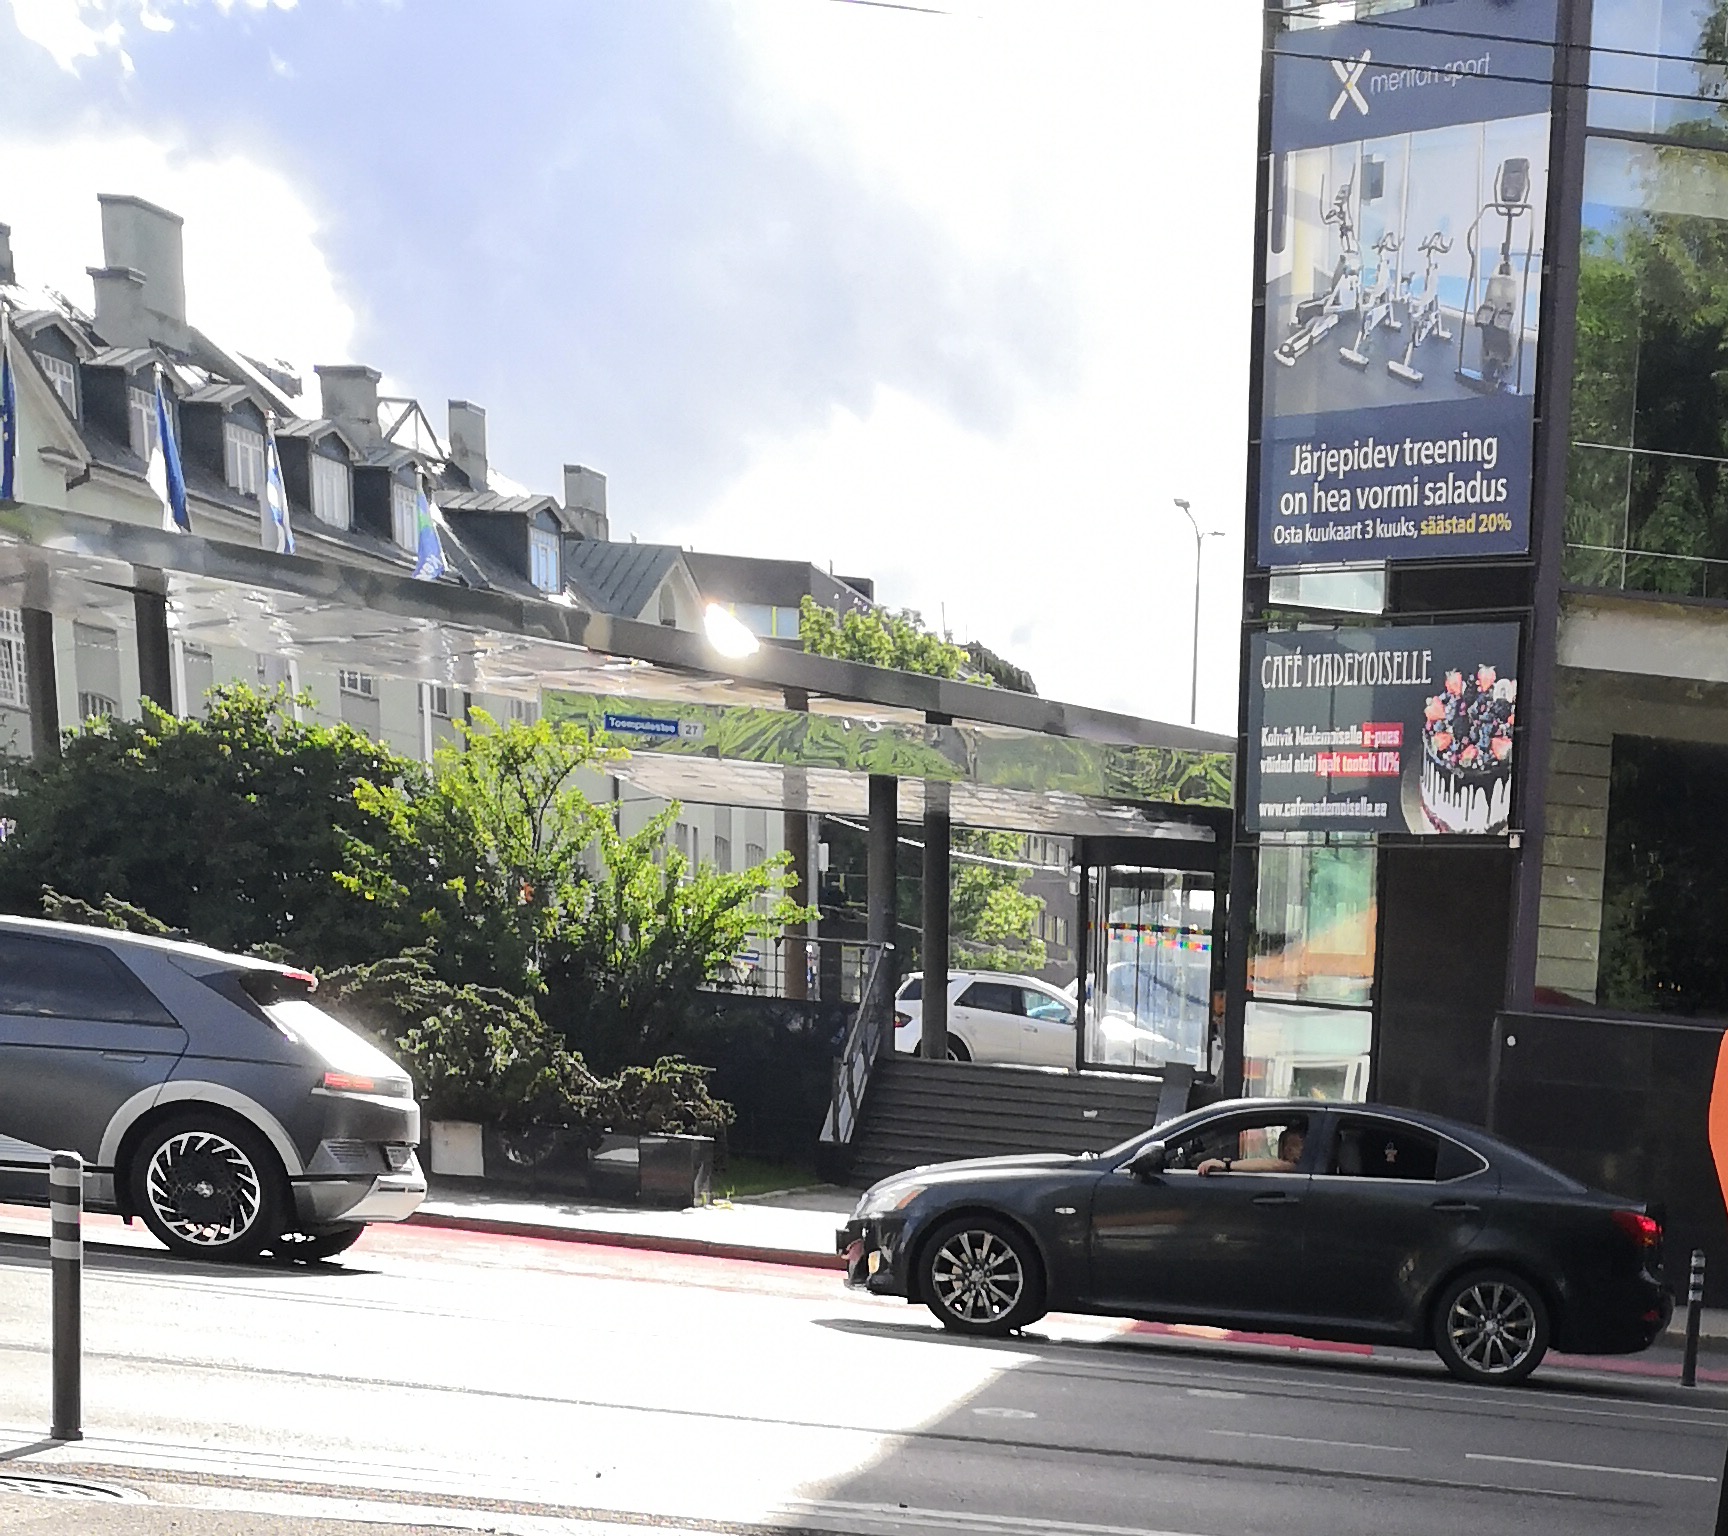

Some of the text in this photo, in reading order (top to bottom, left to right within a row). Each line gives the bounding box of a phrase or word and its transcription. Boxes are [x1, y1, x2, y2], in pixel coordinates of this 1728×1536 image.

[1443, 52, 1490, 87] sport
[1290, 431, 1497, 480] Järjepidev treening
[1280, 471, 1507, 516] on hea vormi saladus
[1273, 513, 1512, 544] Osta kuukaart 3 kuuks, säästad 20%
[1261, 645, 1432, 688] CAFÉ MADEMOISELLE
[685, 725, 698, 735] 27
[1295, 725, 1363, 746] Mademoiselle
[1378, 751, 1400, 773] 10%
[1259, 796, 1388, 817] www.cafemademoiselle.ee
